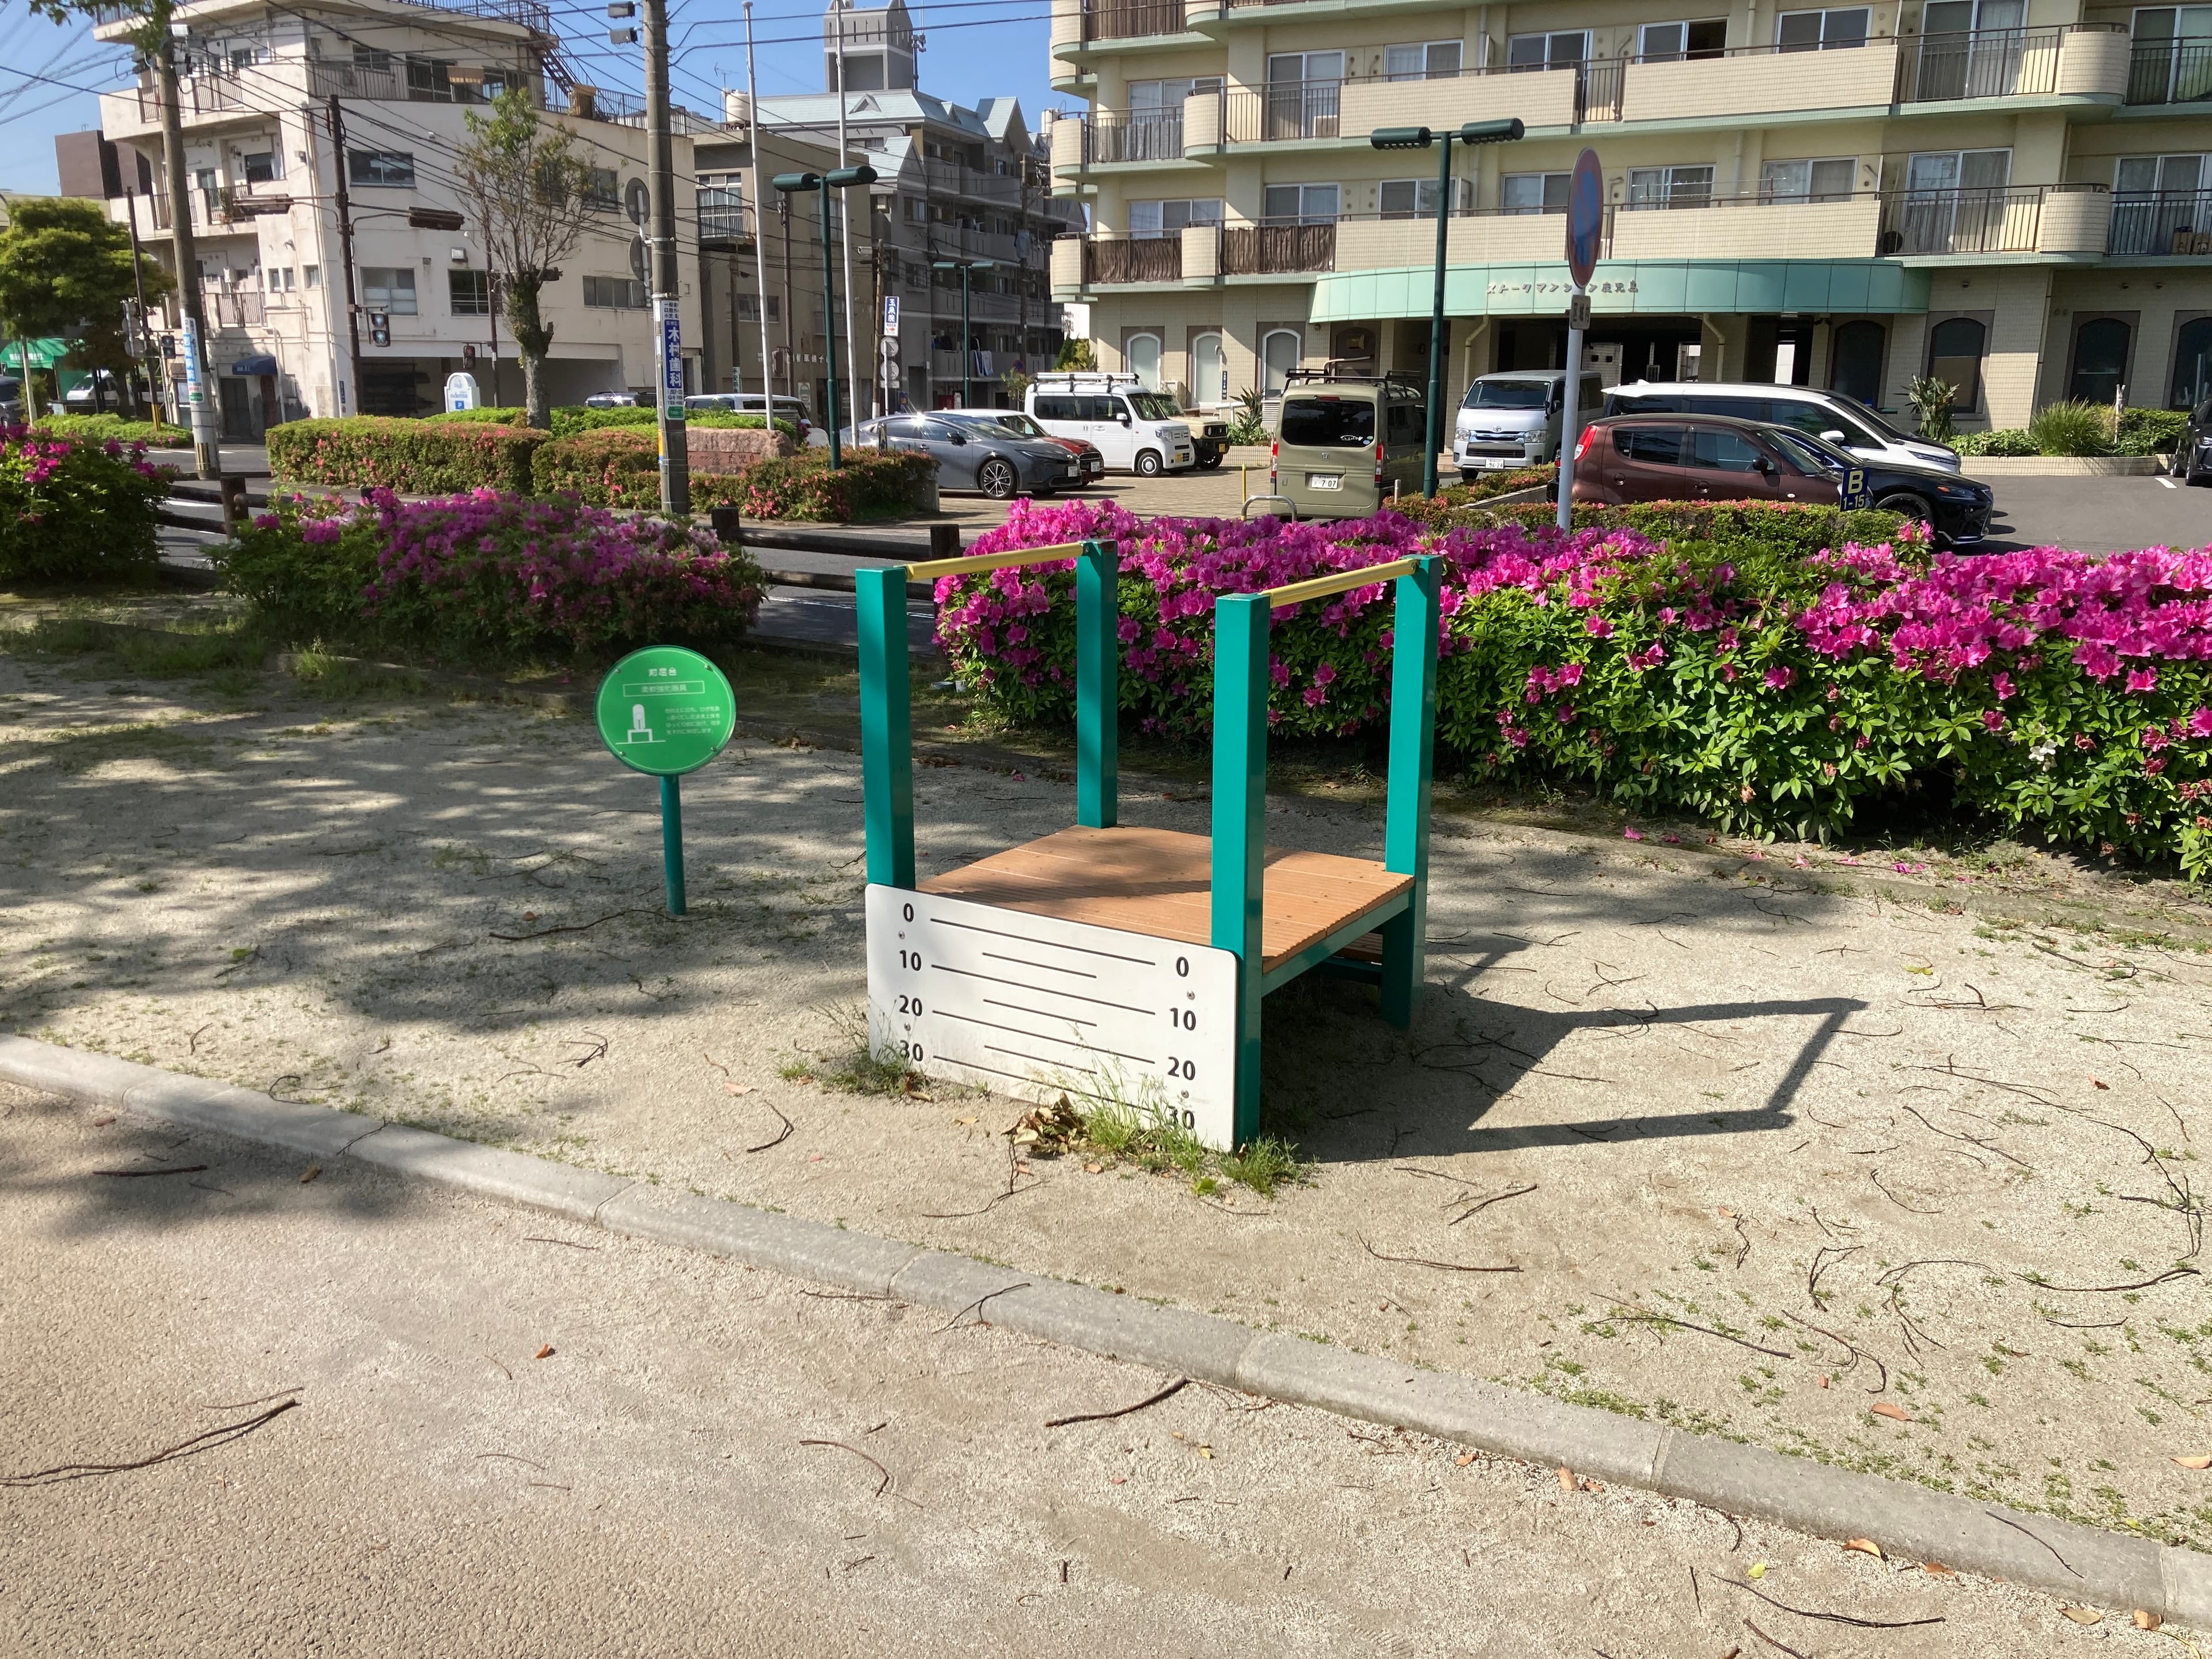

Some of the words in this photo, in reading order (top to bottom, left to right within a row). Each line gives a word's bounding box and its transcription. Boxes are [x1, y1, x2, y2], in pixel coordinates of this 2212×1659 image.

[1487, 280, 1639, 294] ストークマンシン鹿児島
[668, 327, 681, 387] 木村歯科
[1848, 470, 1864, 494] B
[1843, 494, 1865, 510] 1-15
[903, 903, 915, 922] 0
[899, 950, 922, 971] 10
[1176, 956, 1190, 978] 0
[899, 995, 923, 1017] 20
[1170, 1007, 1196, 1031] 10
[900, 1040, 923, 1061] 30
[1168, 1056, 1196, 1080] 20
